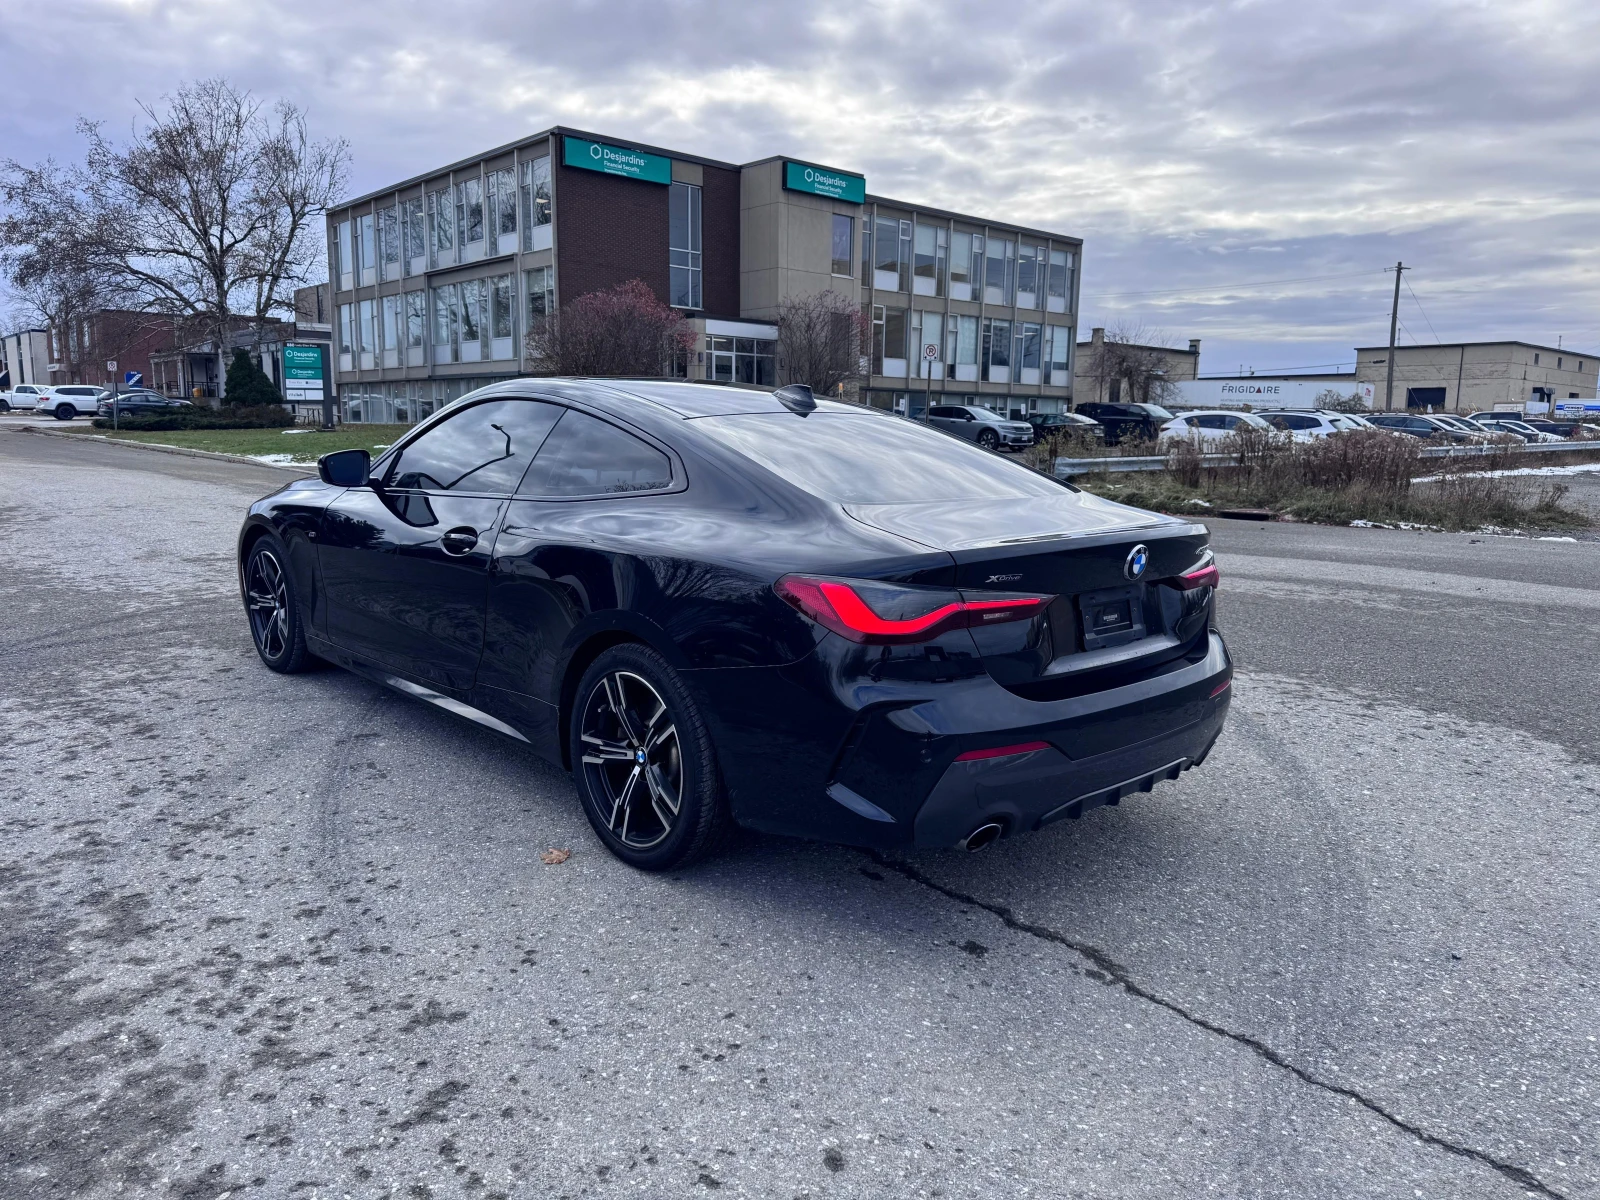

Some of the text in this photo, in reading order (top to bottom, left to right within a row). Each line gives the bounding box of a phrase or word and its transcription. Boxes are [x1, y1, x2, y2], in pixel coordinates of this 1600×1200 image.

[603, 149, 645, 166] Desjardins
[603, 160, 623, 169] Financial
[623, 163, 640, 173] Security
[814, 172, 846, 187] Desjardins
[1221, 385, 1281, 394] FRIGIDAIRE
